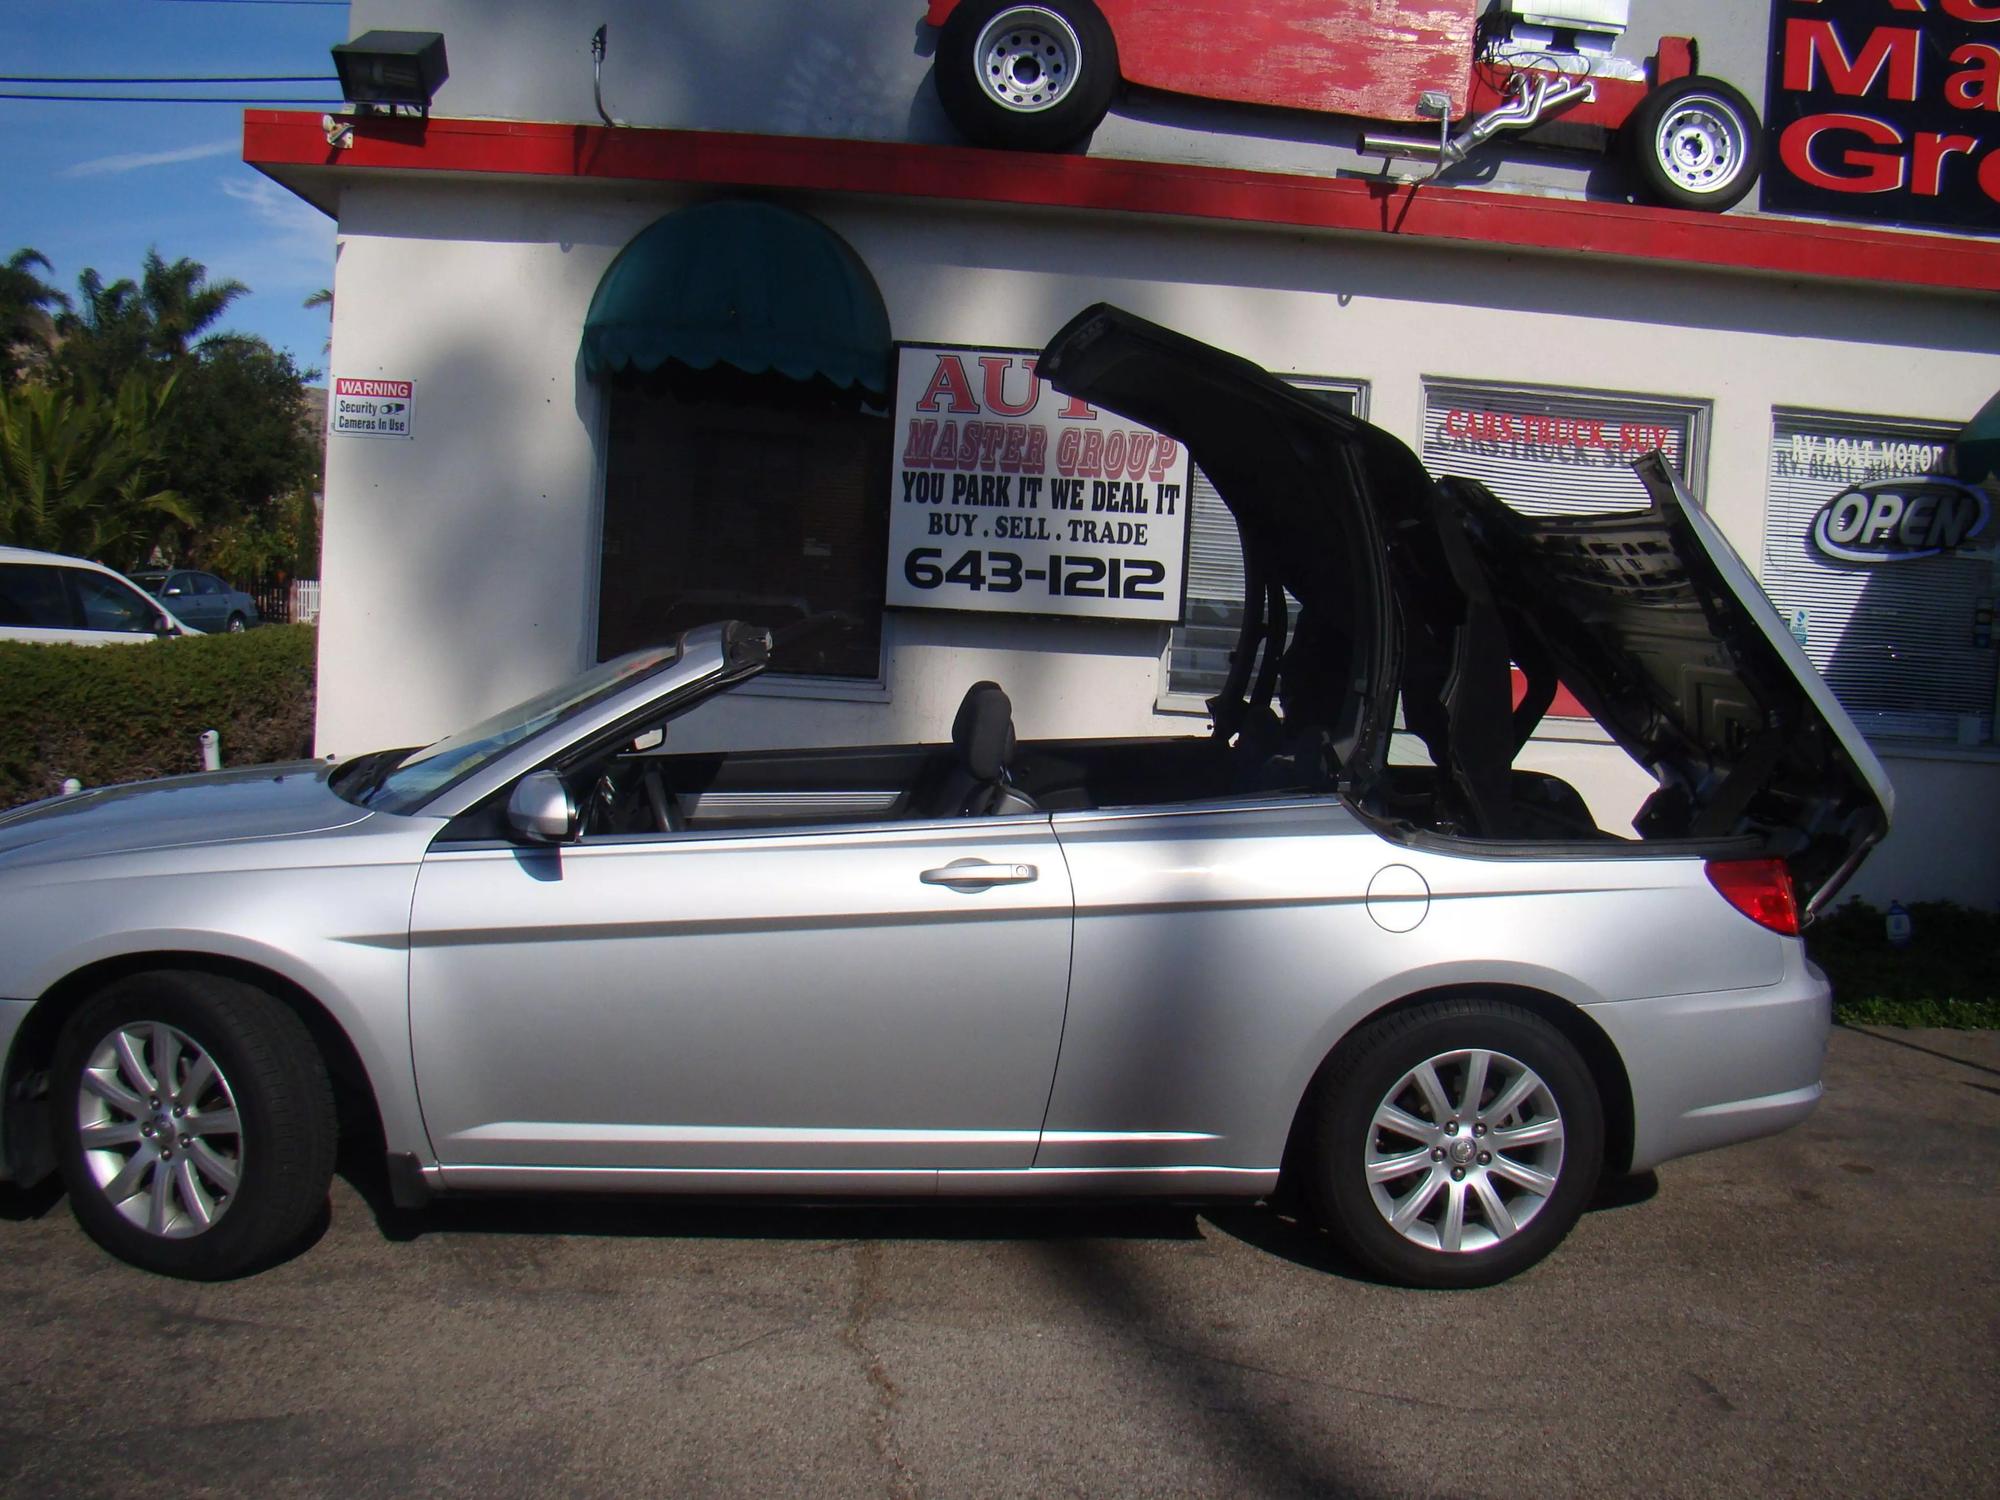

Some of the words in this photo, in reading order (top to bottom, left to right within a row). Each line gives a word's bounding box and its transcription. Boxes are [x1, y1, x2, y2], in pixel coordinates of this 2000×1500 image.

[340, 381, 408, 396] WARNING
[339, 416, 375, 429] Cameras
[389, 419, 405, 431] Use
[340, 400, 378, 416] Security
[903, 418, 1047, 475] MASTER
[1055, 426, 1178, 482] GROUP
[902, 471, 945, 506] YOU
[951, 473, 1011, 508] PARK
[1017, 476, 1043, 508] IT
[1051, 478, 1084, 511] WE
[1091, 480, 1148, 514] DEAL
[1155, 484, 1180, 515] IT
[1067, 519, 1148, 546] TRADE
[1827, 493, 1968, 546] OPEN
[904, 547, 1166, 600] 643-1212
